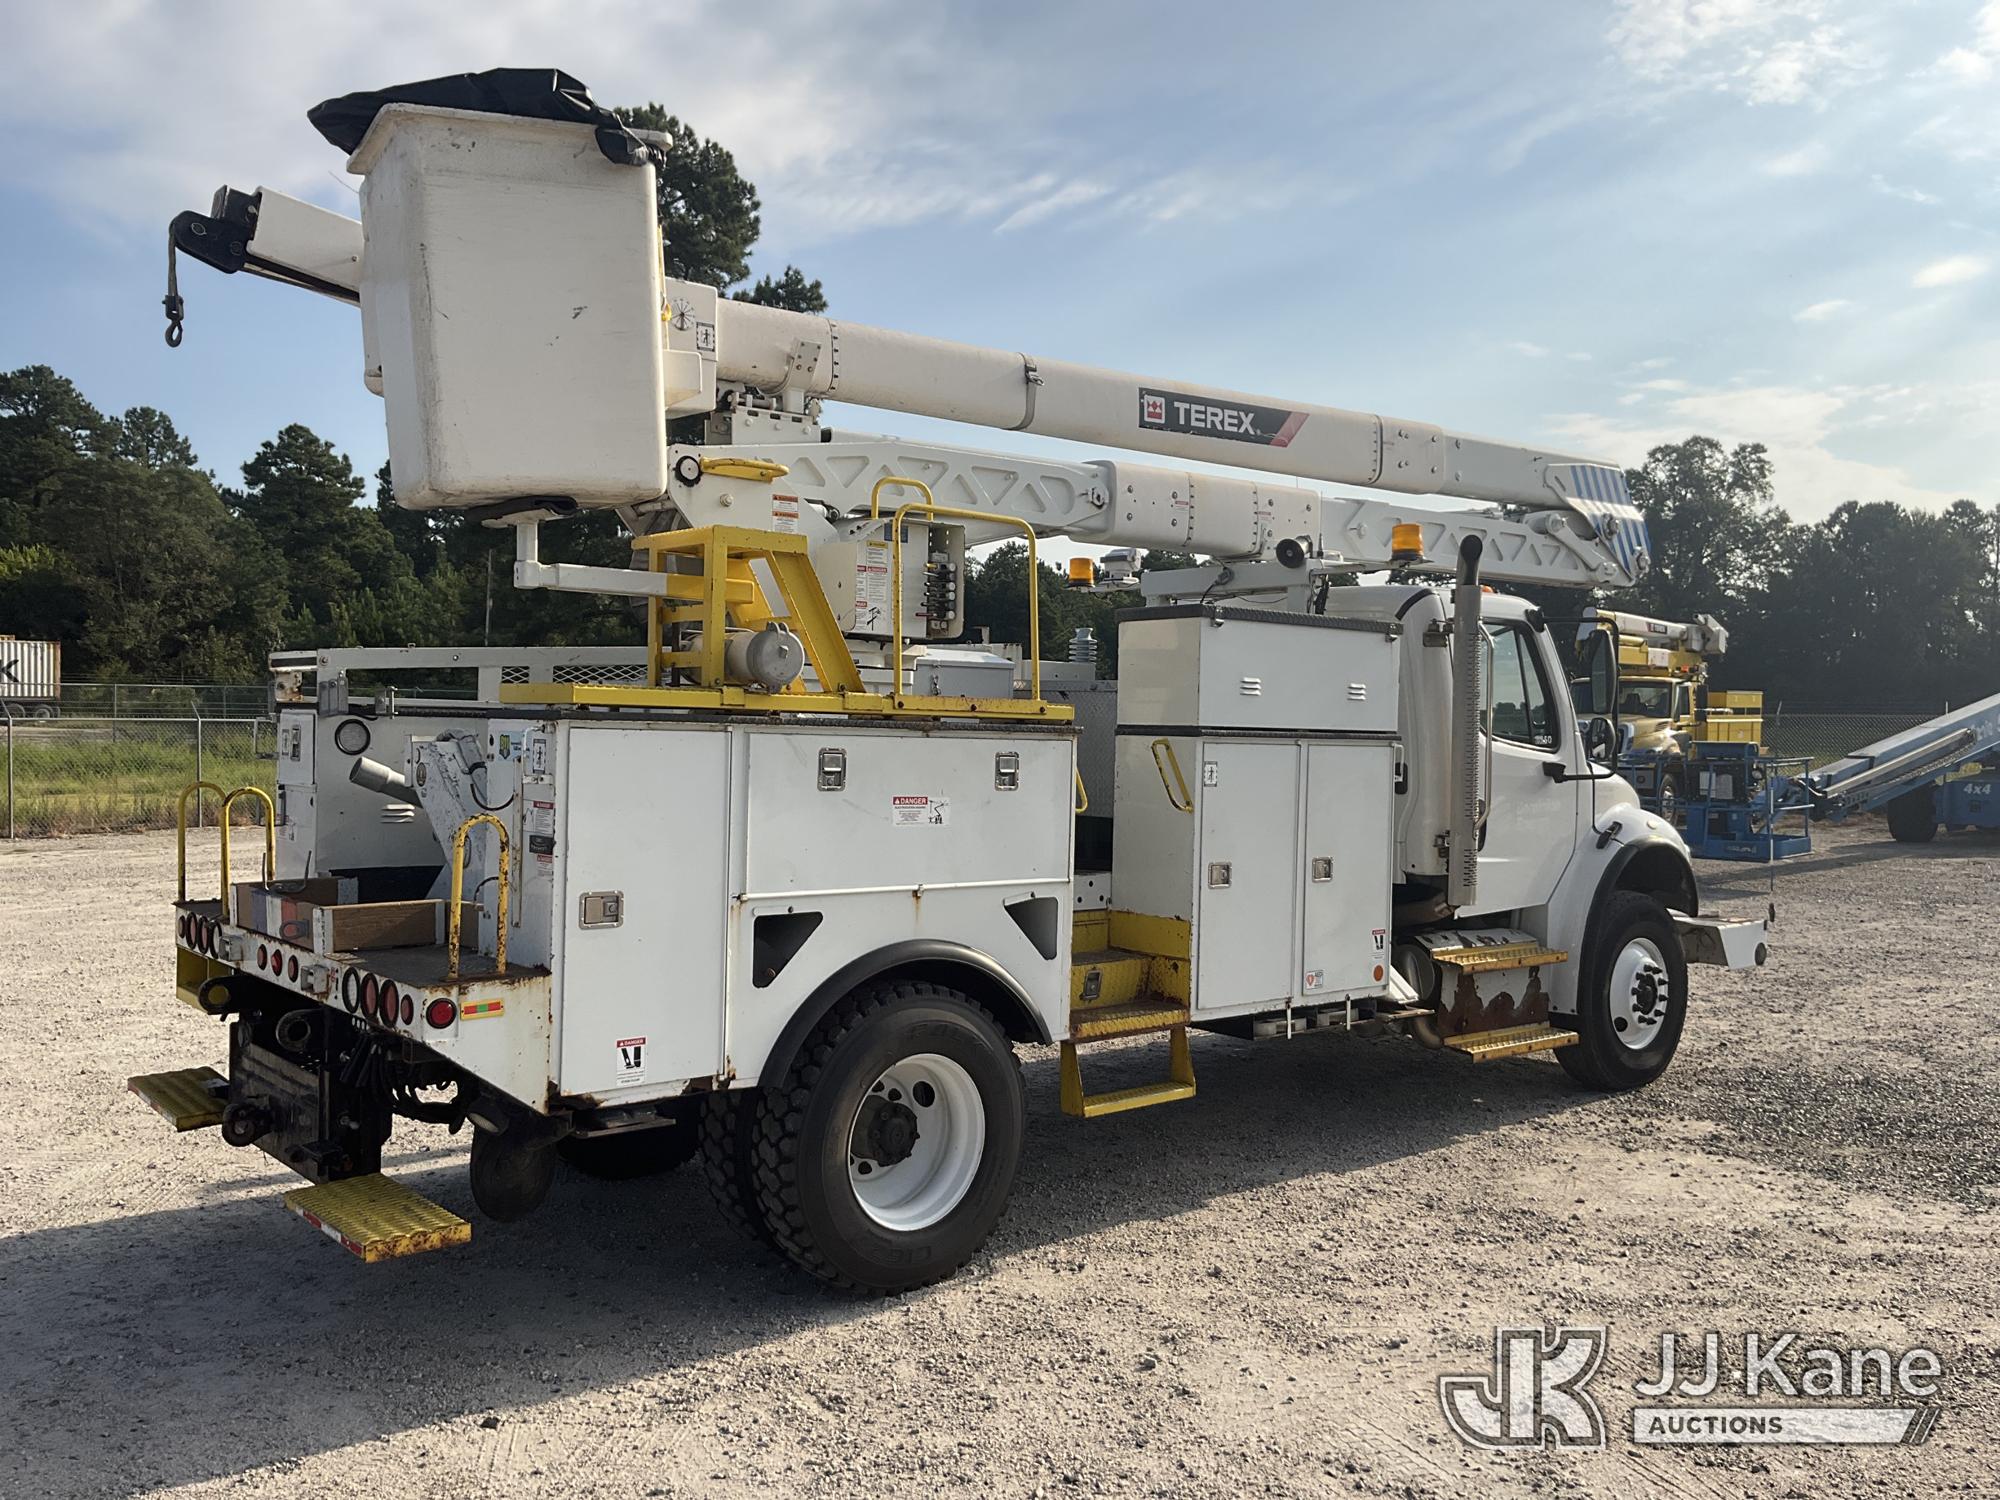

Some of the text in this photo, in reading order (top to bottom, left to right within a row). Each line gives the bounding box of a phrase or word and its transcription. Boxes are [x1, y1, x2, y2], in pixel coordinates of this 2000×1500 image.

[1174, 401, 1255, 435] TEREX
[1963, 783, 1991, 794] 4x4
[900, 797, 927, 805] DANGER
